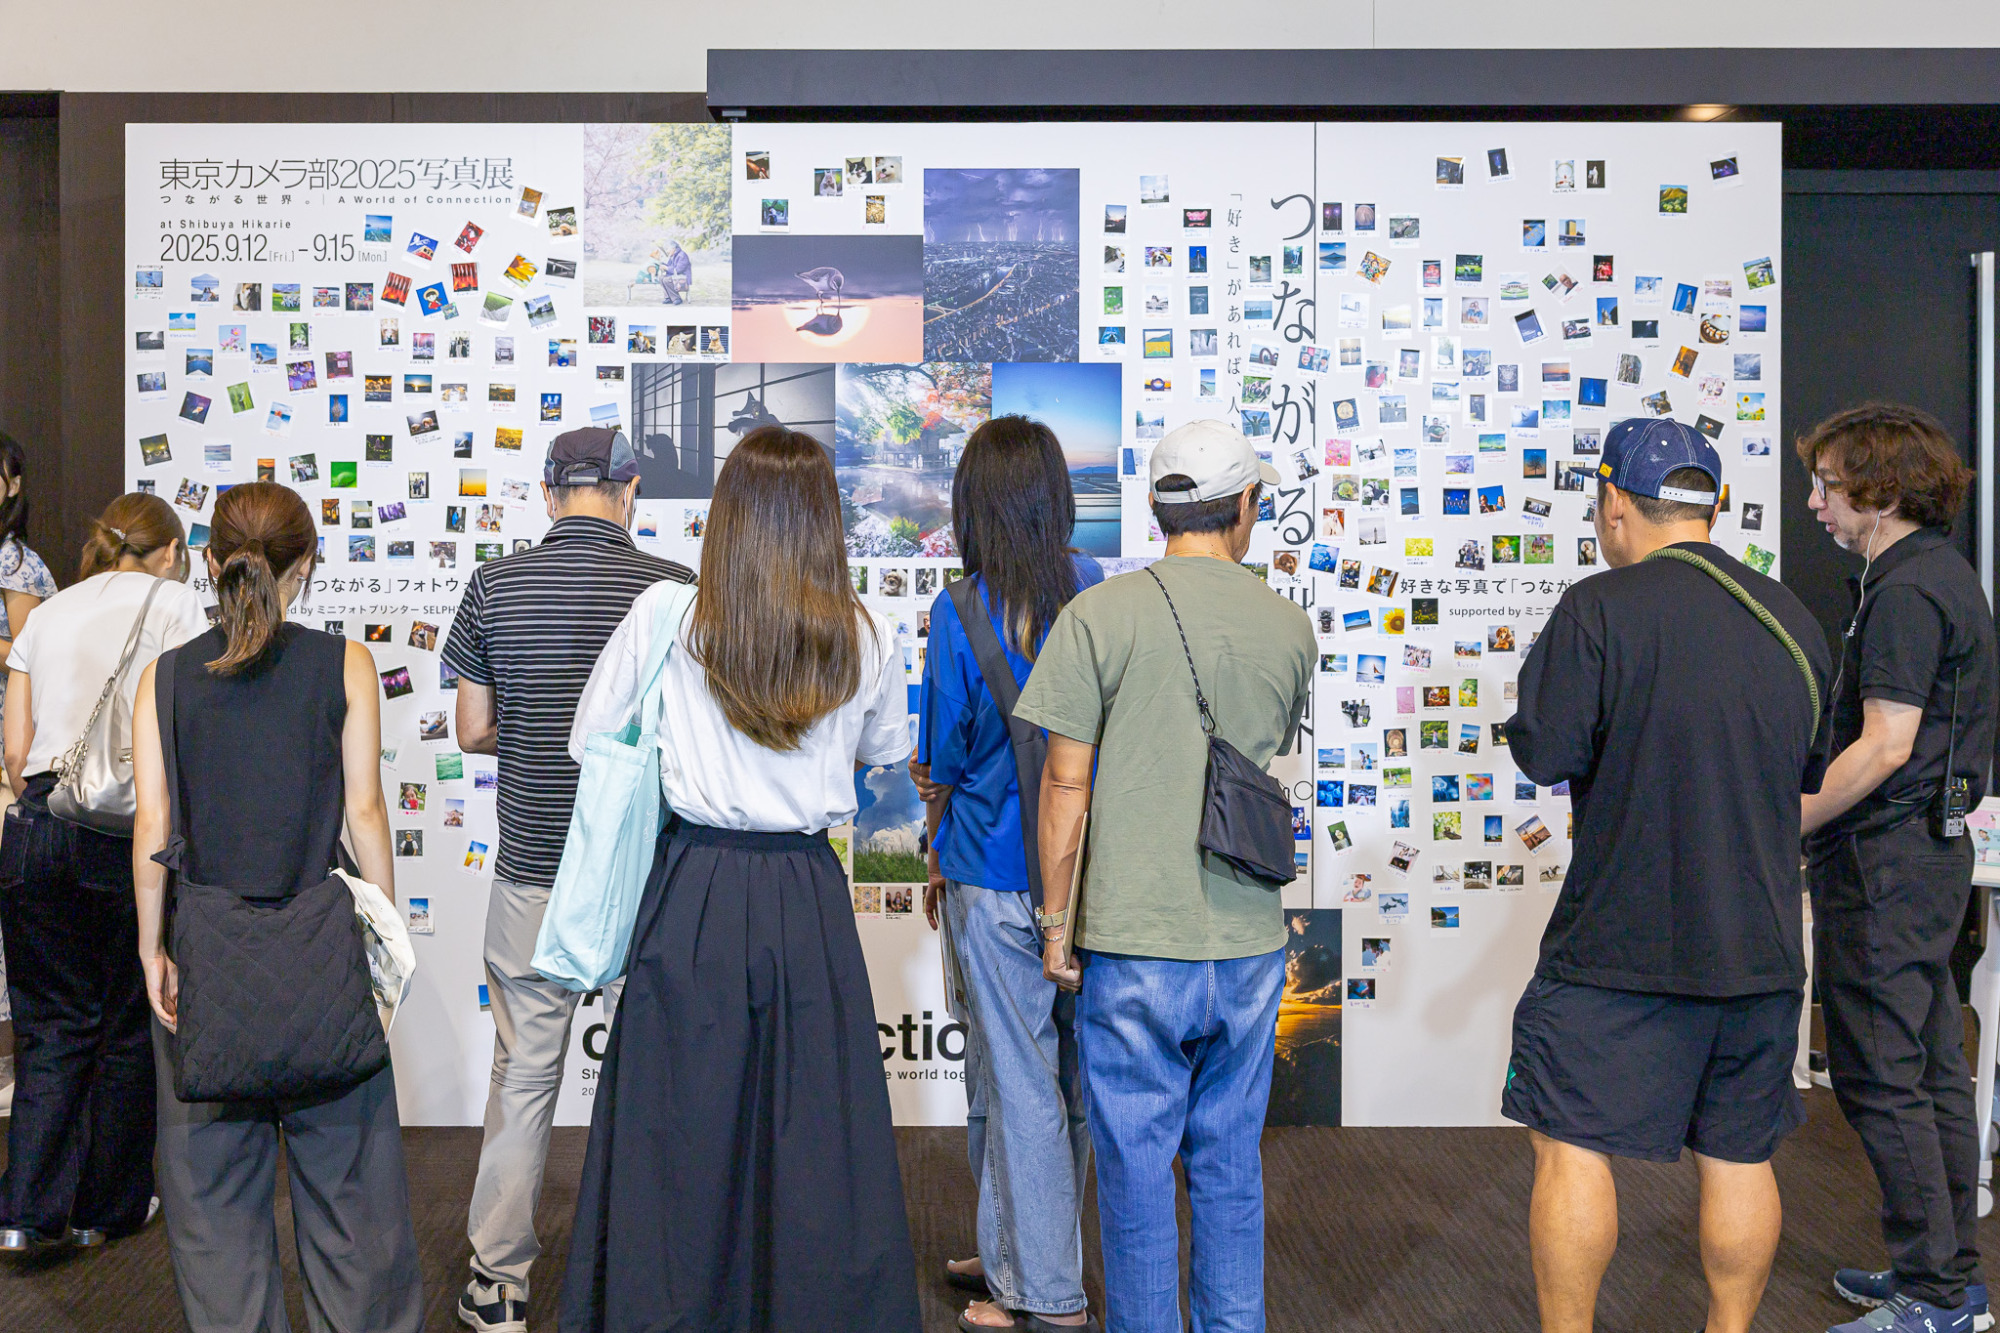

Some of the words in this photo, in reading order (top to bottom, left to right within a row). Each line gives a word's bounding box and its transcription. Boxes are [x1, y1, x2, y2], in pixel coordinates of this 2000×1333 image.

[159, 156, 514, 191] 東京カメラ部2025写真展
[160, 195, 310, 205] つながる世界。
[338, 196, 346, 204] A
[353, 195, 395, 204] World
[404, 195, 417, 204] of
[426, 195, 511, 204] Connection
[160, 219, 172, 229] at
[180, 218, 234, 231] Shibuya
[242, 219, 291, 229] Hikarie
[1227, 193, 1243, 429] 「好き」があれば、人
[1449, 605, 1504, 618] supported
[1509, 606, 1521, 618] by
[581, 1068, 600, 1080] Sh
[897, 1068, 938, 1080] world
[944, 1068, 966, 1083] tog
[581, 1087, 595, 1097] 20
